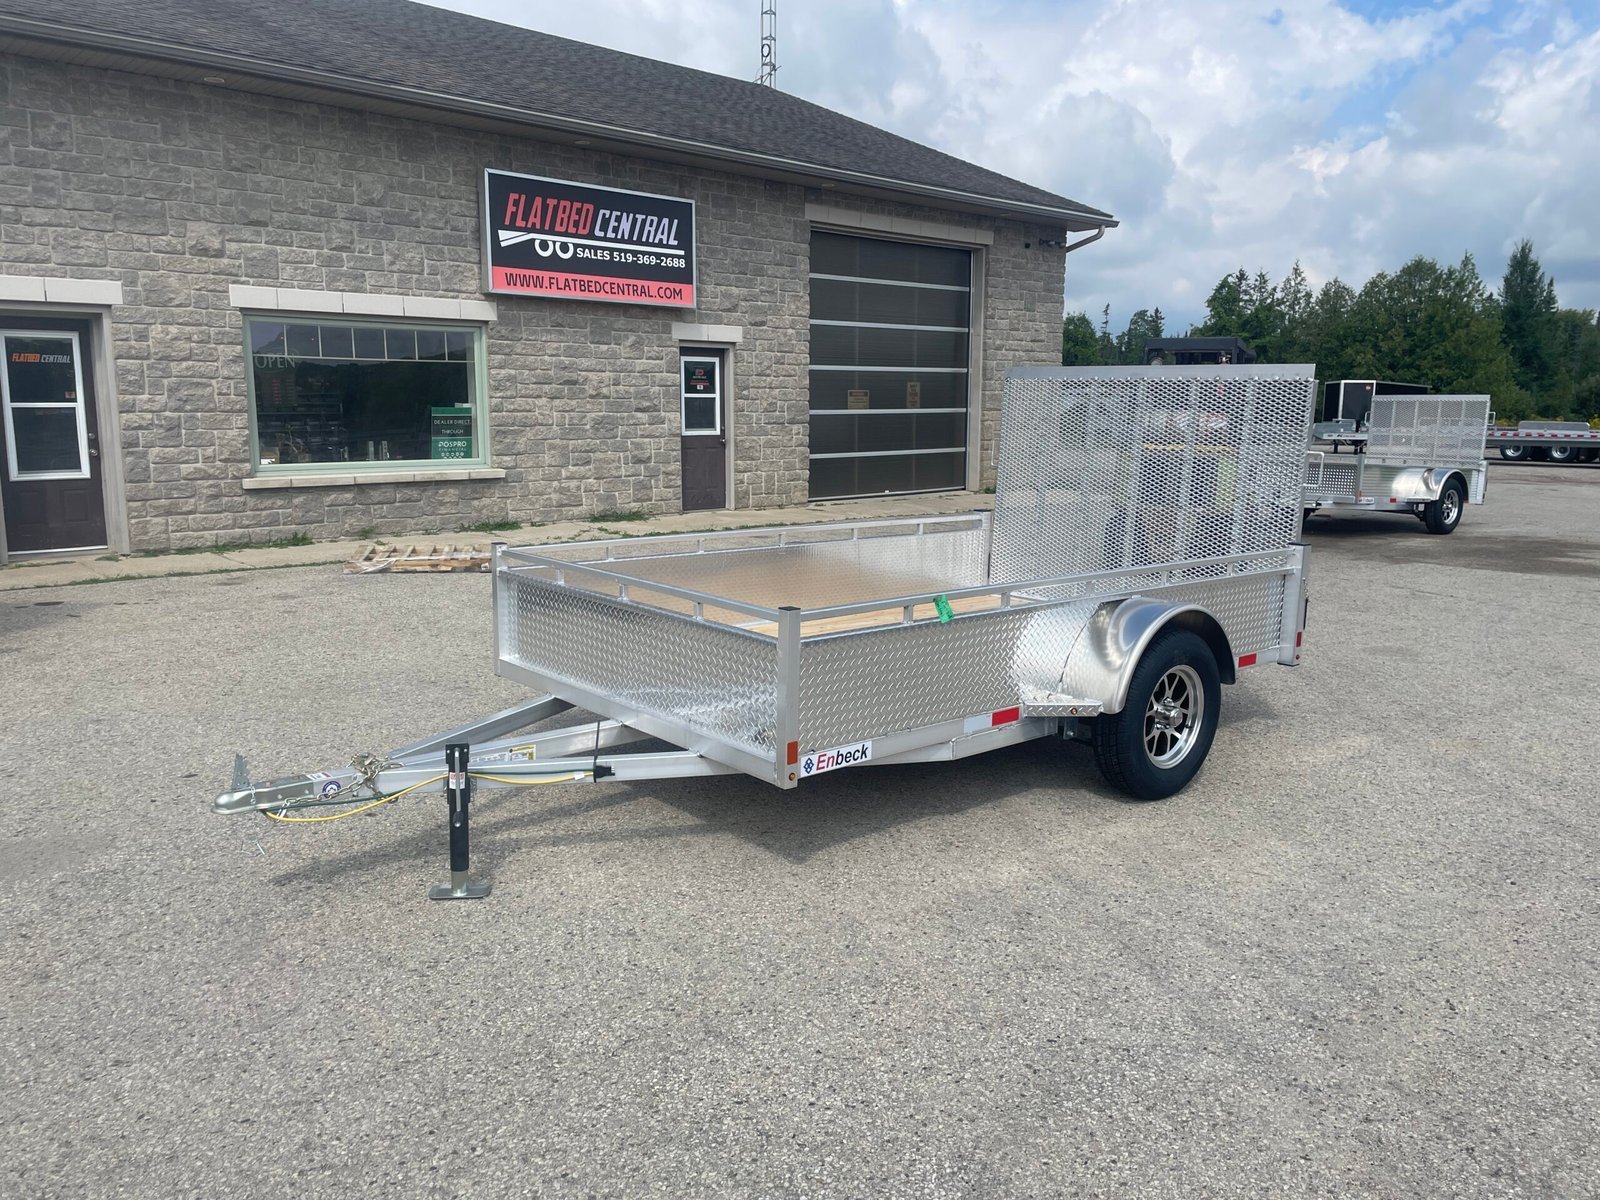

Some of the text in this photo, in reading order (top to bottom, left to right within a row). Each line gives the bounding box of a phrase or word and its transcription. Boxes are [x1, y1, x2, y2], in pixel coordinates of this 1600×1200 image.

[504, 192, 679, 246] FLATBED CENTRAL
[576, 247, 686, 268] SALES 519-369-2688
[504, 272, 683, 300] WWW.FLATBEDCENTRAL.COM
[41, 354, 71, 364] CENTRAL
[254, 352, 296, 369] OPEN
[815, 743, 869, 771] Enbeck
